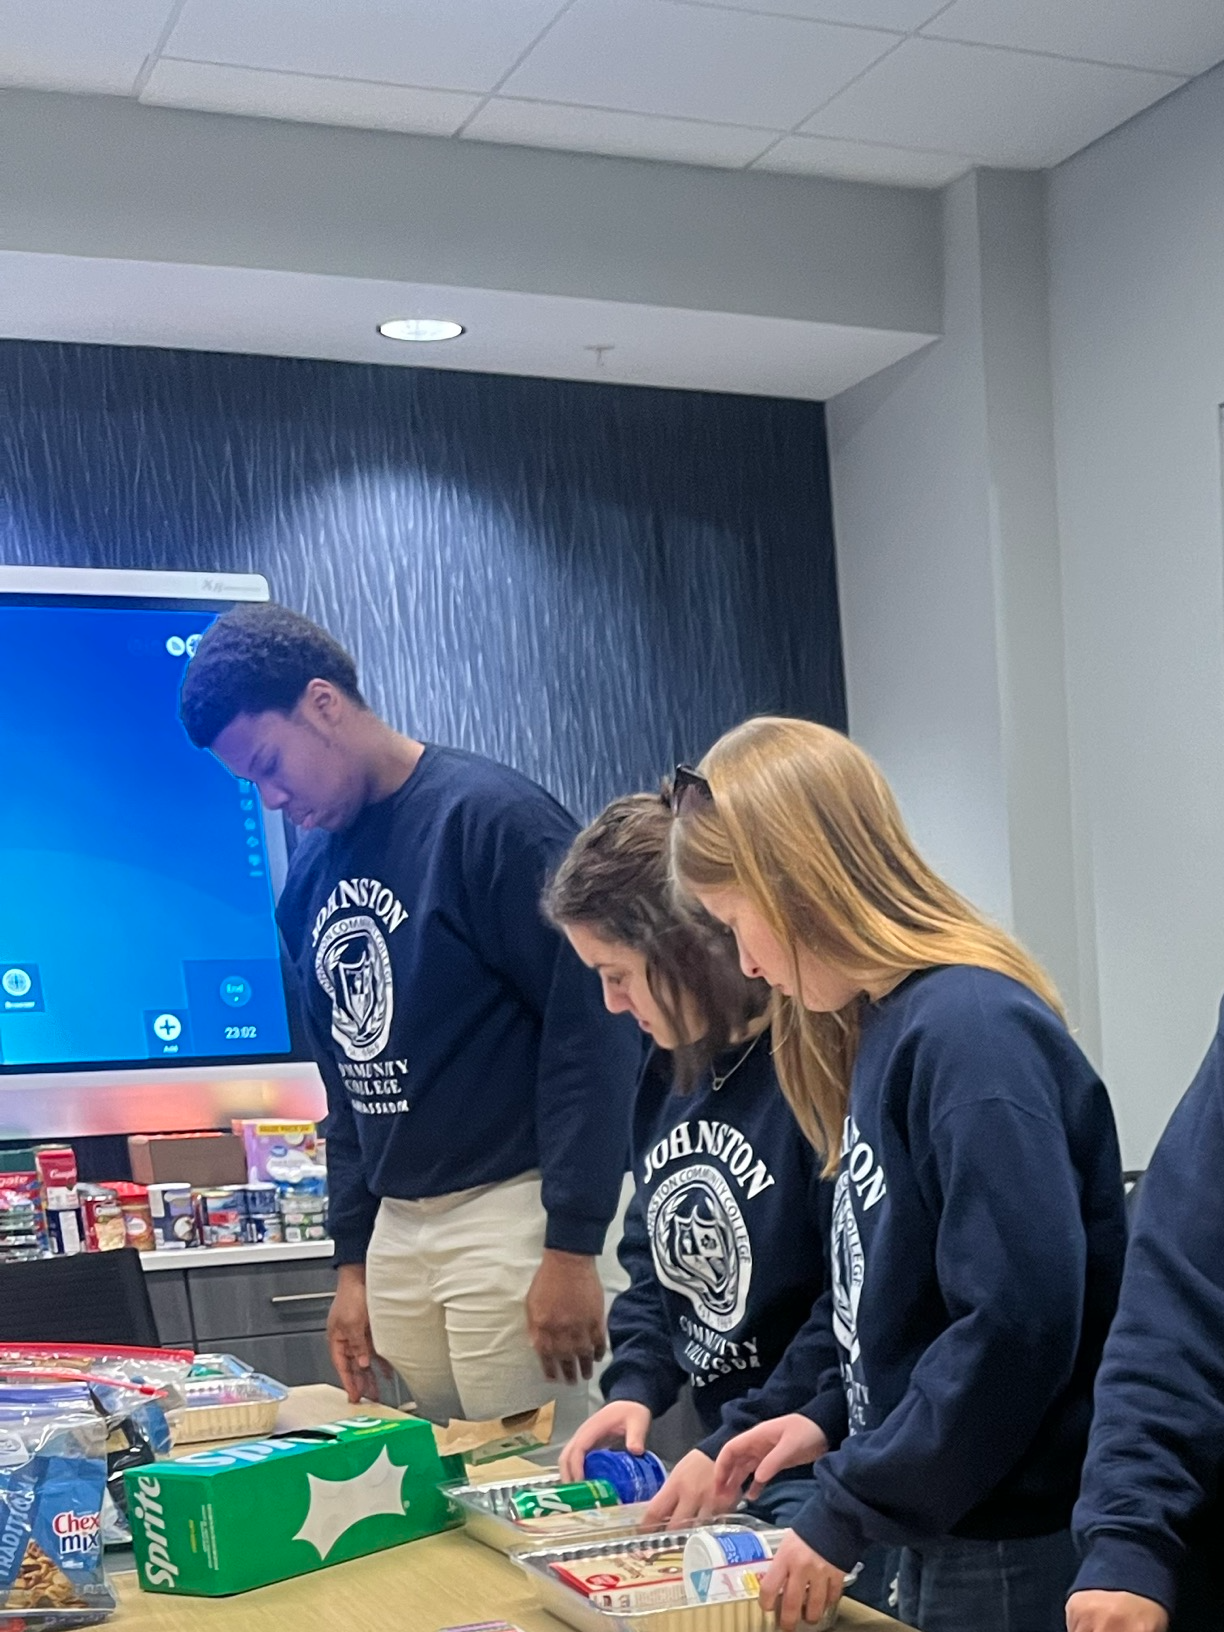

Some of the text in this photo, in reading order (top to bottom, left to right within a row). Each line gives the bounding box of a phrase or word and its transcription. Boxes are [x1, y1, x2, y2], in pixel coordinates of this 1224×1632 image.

[312, 878, 408, 947] JOHNSTON
[224, 1026, 257, 1039] 23:02
[644, 1120, 775, 1200] JOHNSTON
[53, 1511, 100, 1535] Chex
[60, 1532, 98, 1555] mix
[135, 1476, 177, 1588] Sprite
